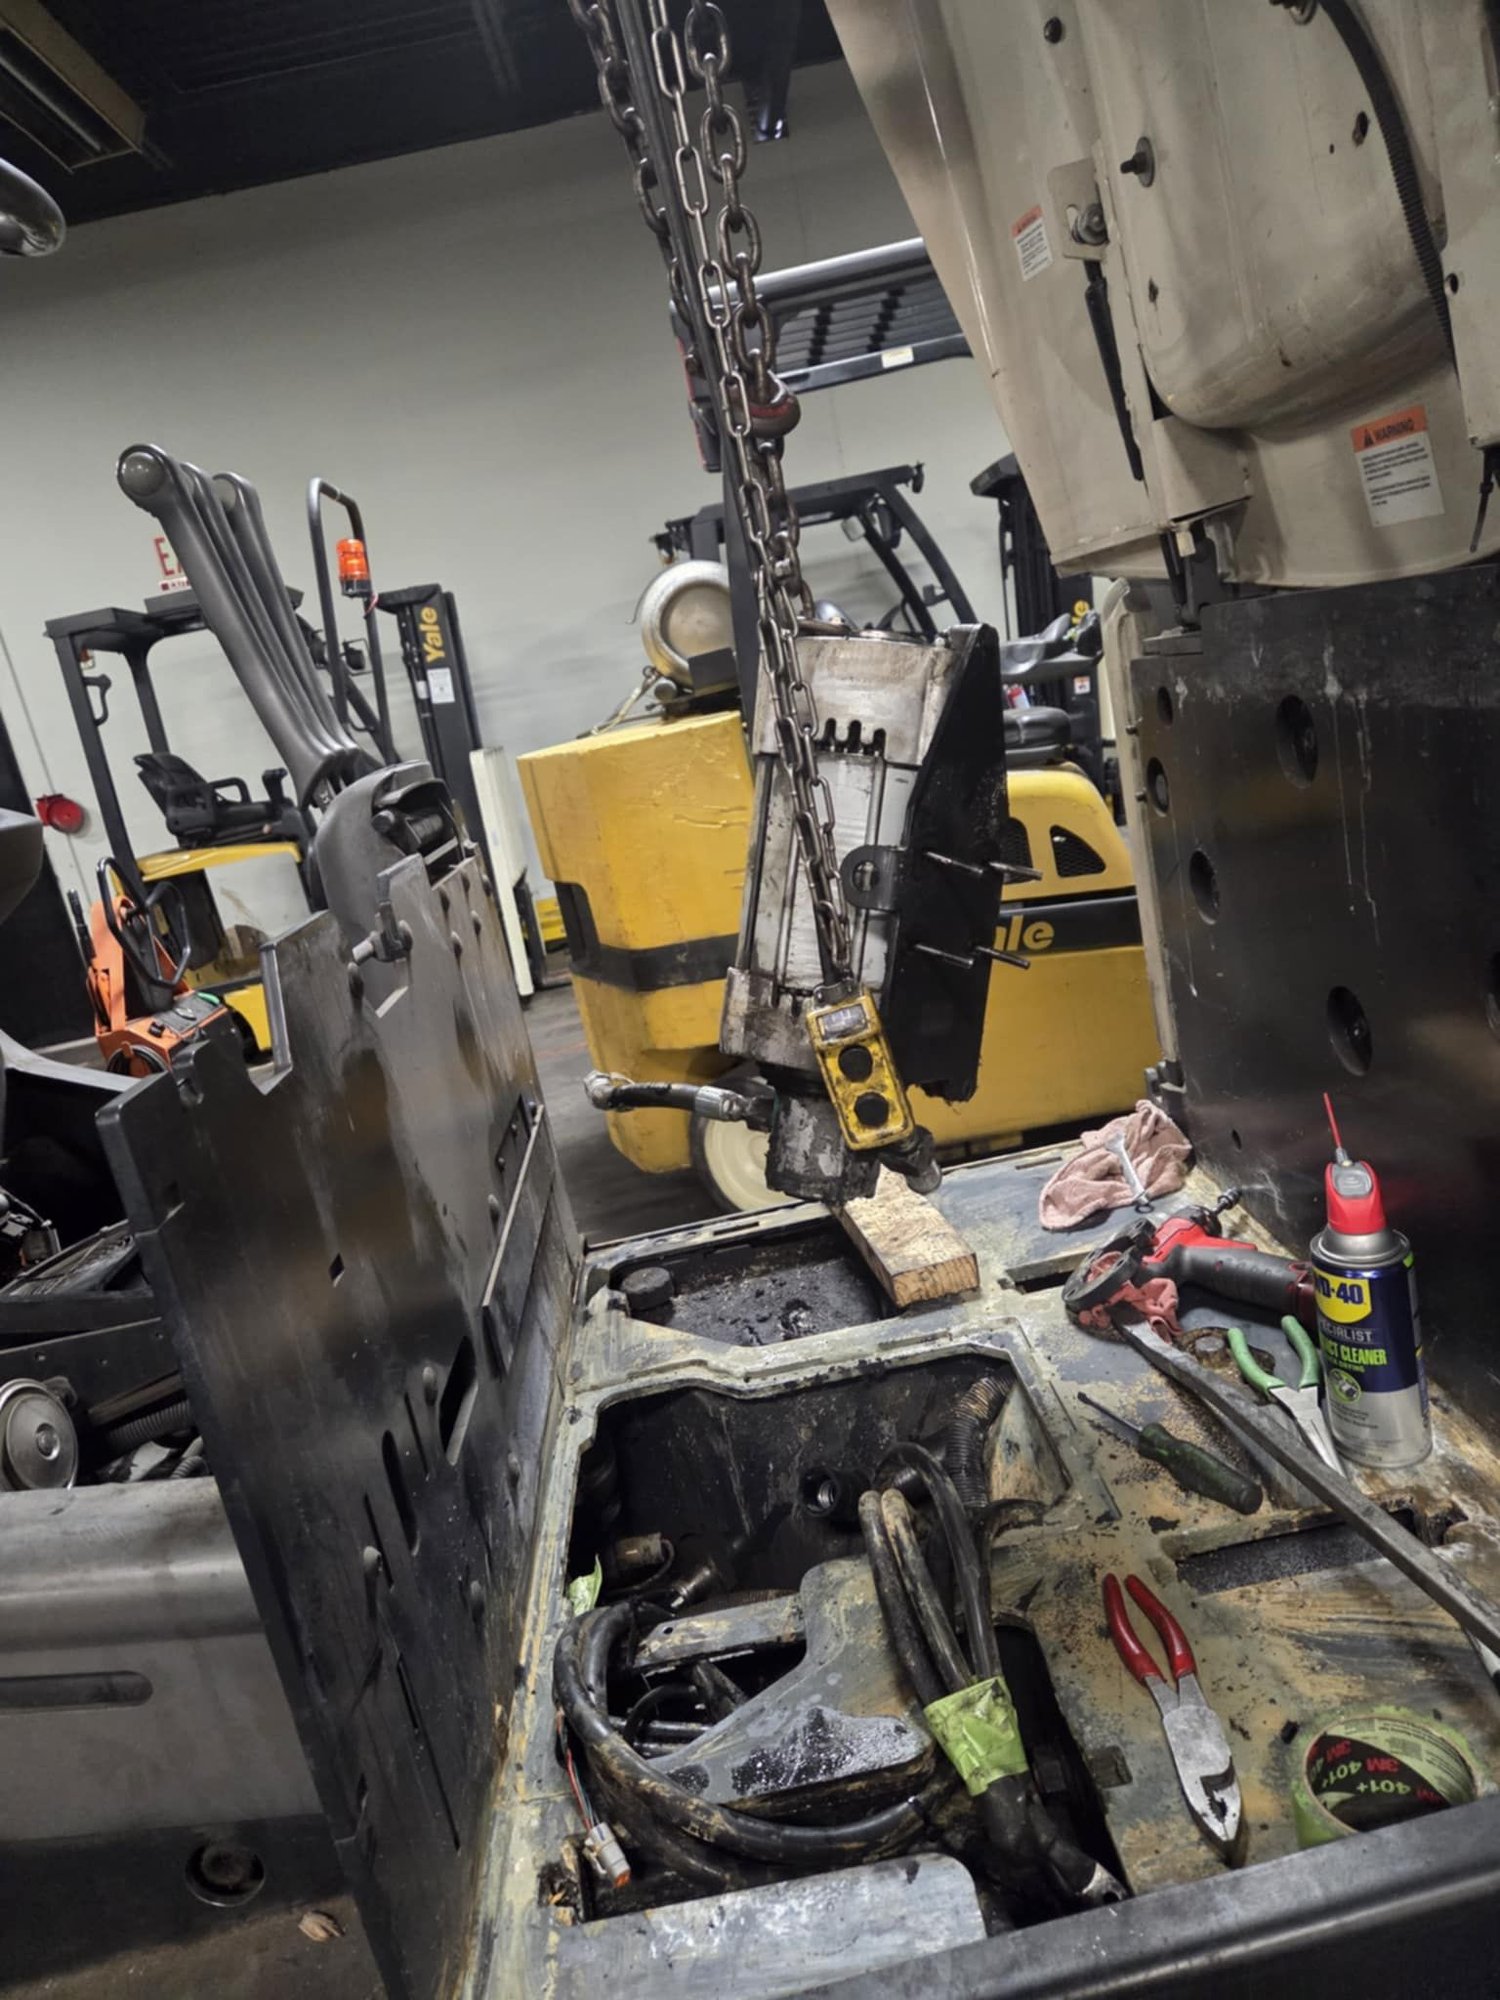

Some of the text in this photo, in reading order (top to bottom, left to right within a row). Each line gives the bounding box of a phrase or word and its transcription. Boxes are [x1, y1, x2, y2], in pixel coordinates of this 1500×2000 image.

[1375, 417, 1415, 442] WARNING
[419, 606, 446, 662] Yale
[993, 914, 1055, 951] le
[1341, 1346, 1388, 1366] CLEANER
[1325, 1740, 1351, 1762] 3M
[1366, 1757, 1399, 1773] 3M
[1356, 1779, 1411, 1795] 401+
